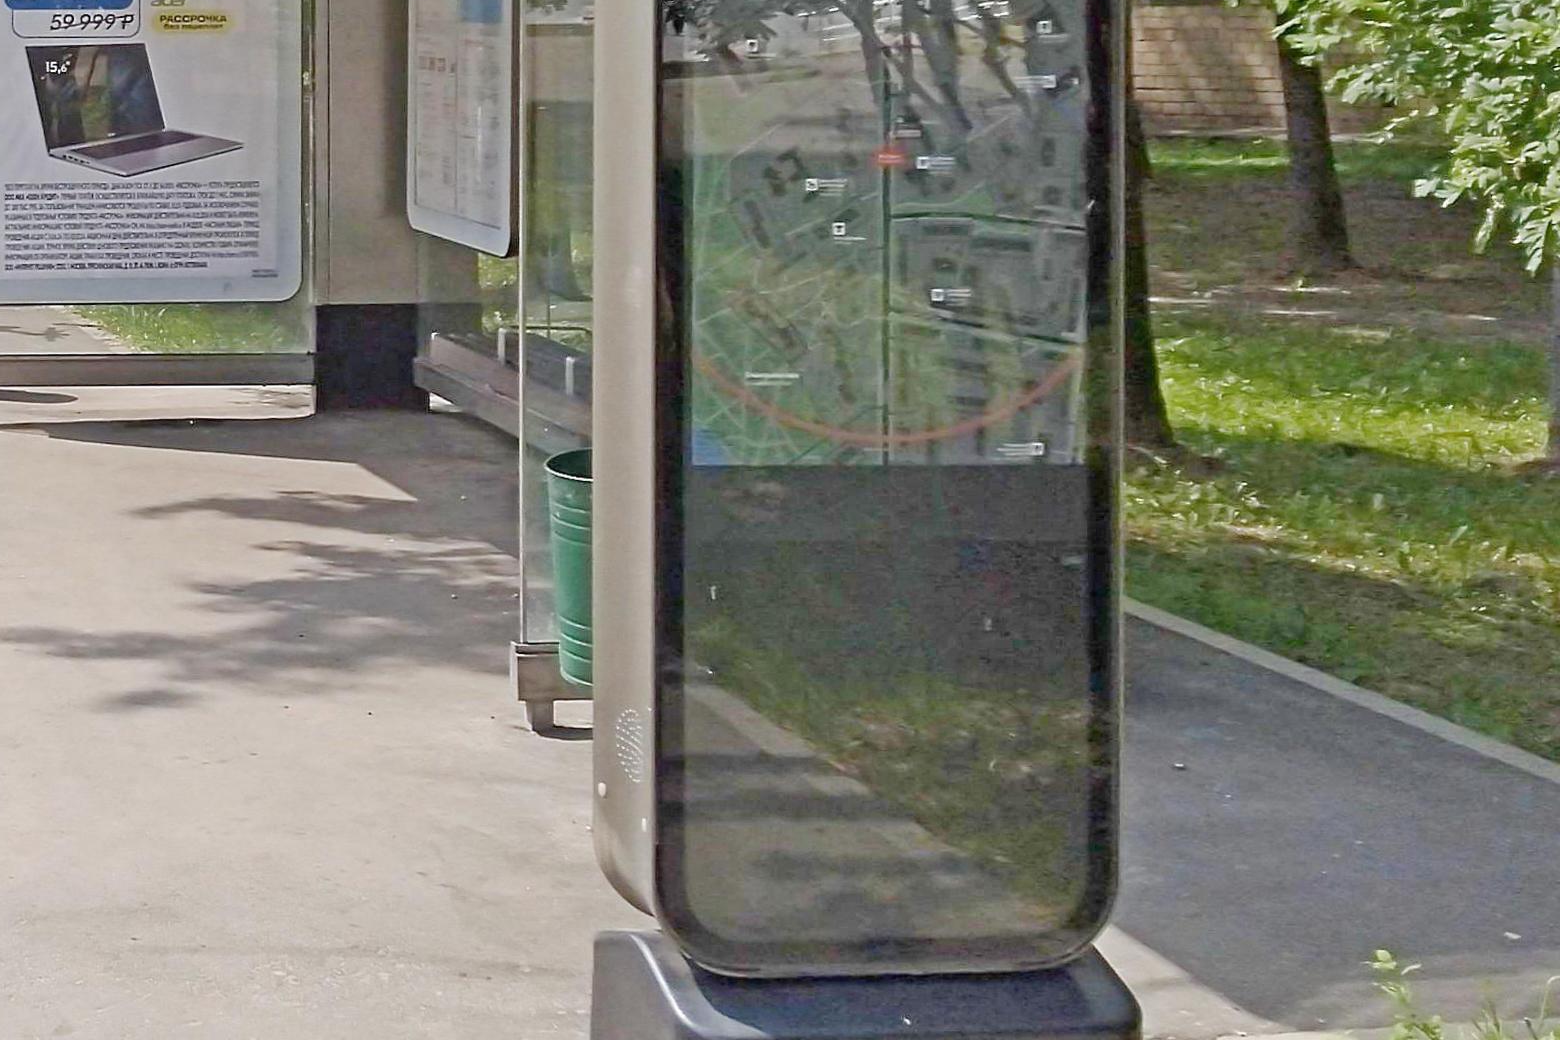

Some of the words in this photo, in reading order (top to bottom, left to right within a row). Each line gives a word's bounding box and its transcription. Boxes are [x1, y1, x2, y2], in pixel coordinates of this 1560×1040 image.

[49, 13, 75, 30] 59
[79, 13, 116, 30] 999
[159, 14, 227, 23] РАССРОЧКА
